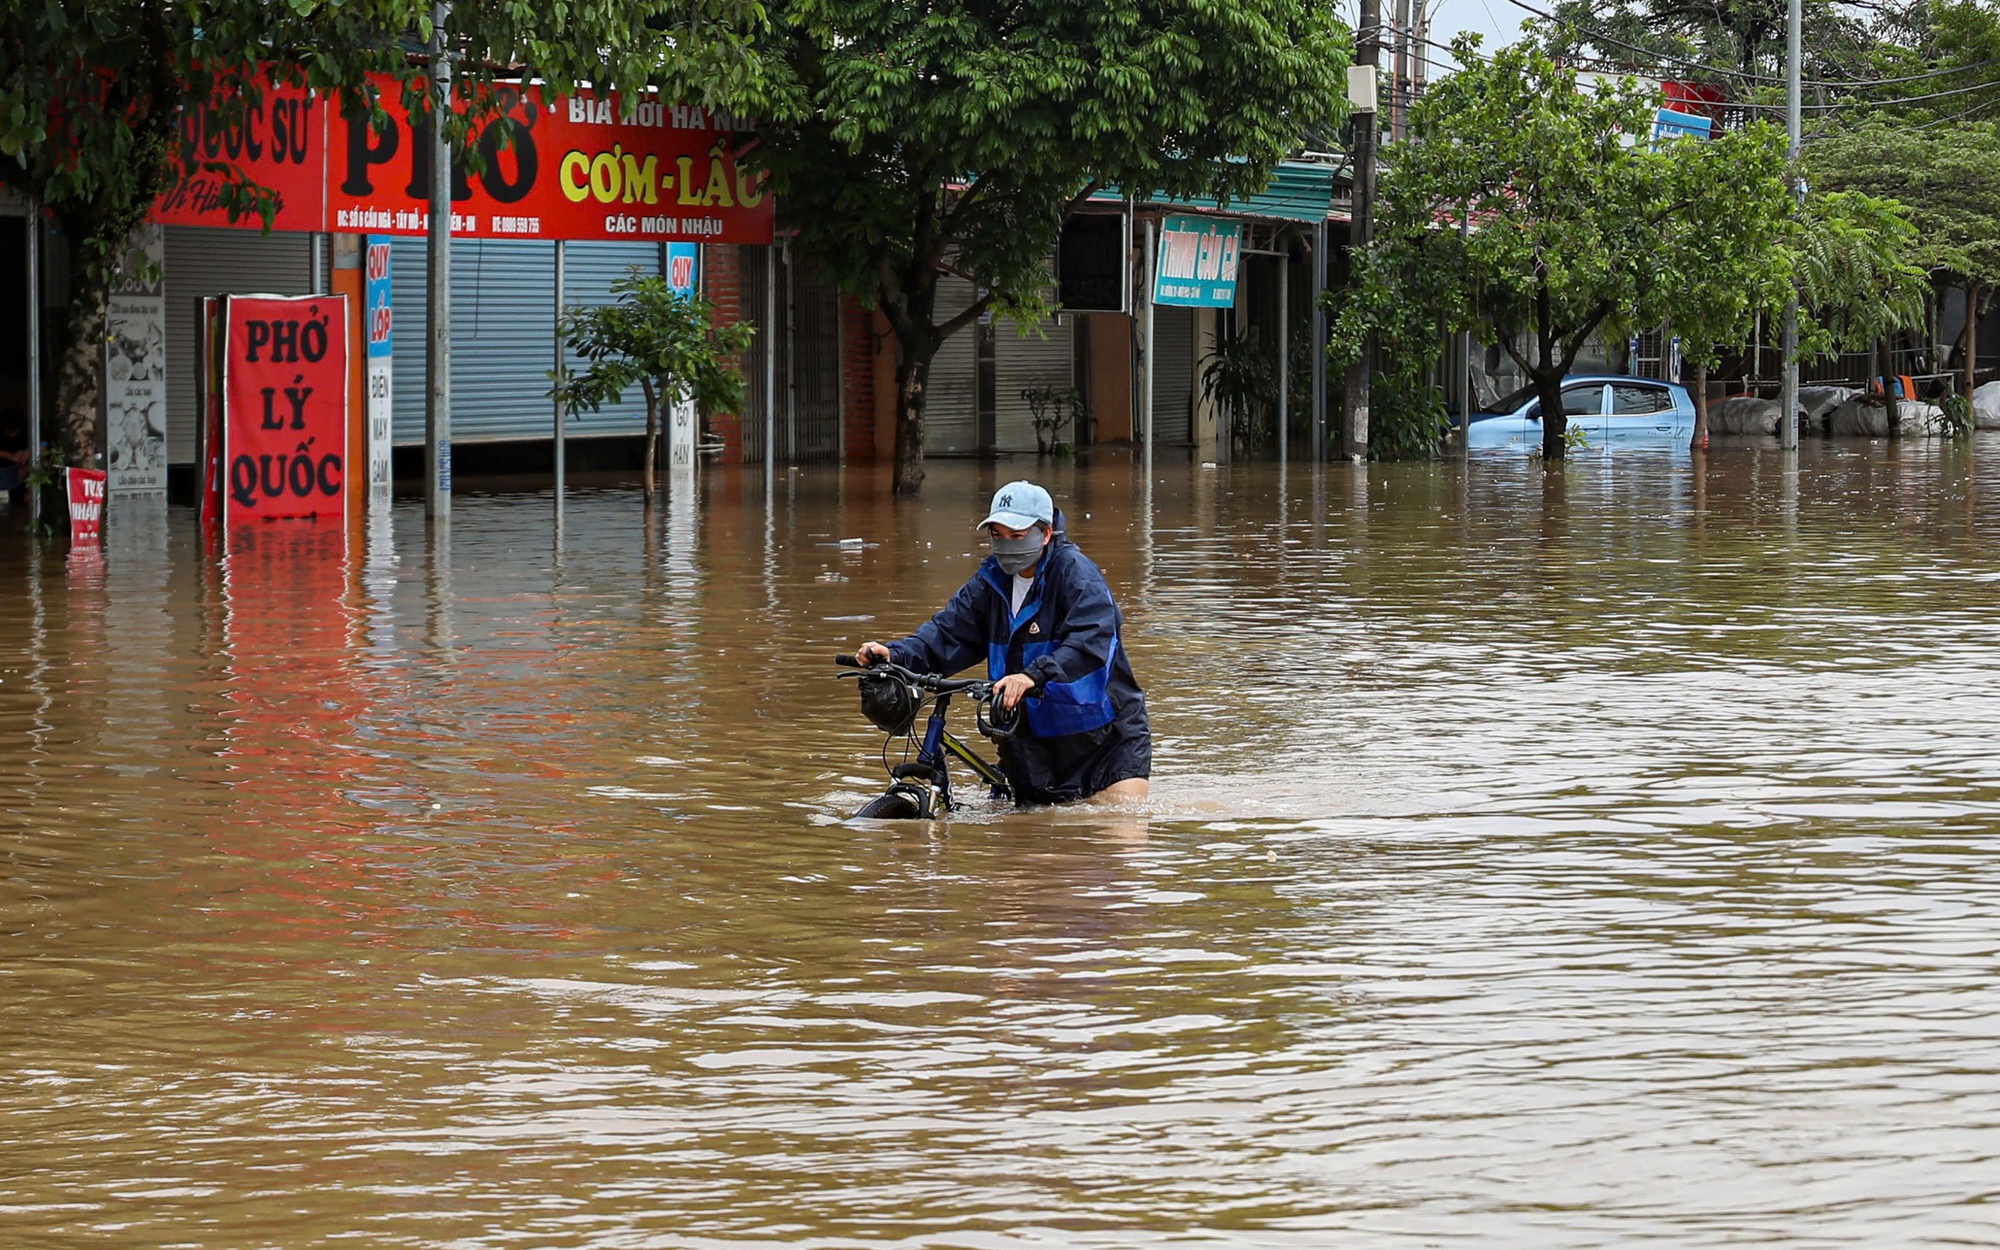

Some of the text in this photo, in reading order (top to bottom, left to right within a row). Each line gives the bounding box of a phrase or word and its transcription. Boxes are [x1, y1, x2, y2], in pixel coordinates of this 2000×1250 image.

[569, 98, 613, 125] BIA
[528, 217, 540, 234] 755
[605, 213, 723, 238] CÁC MÓN NHẬU
[368, 244, 391, 282] QUY
[672, 256, 694, 290] QUY
[245, 305, 329, 363] PHỞ
[371, 290, 391, 343] LỐP
[261, 374, 313, 431] LÝ
[231, 436, 341, 508] QUỐC
